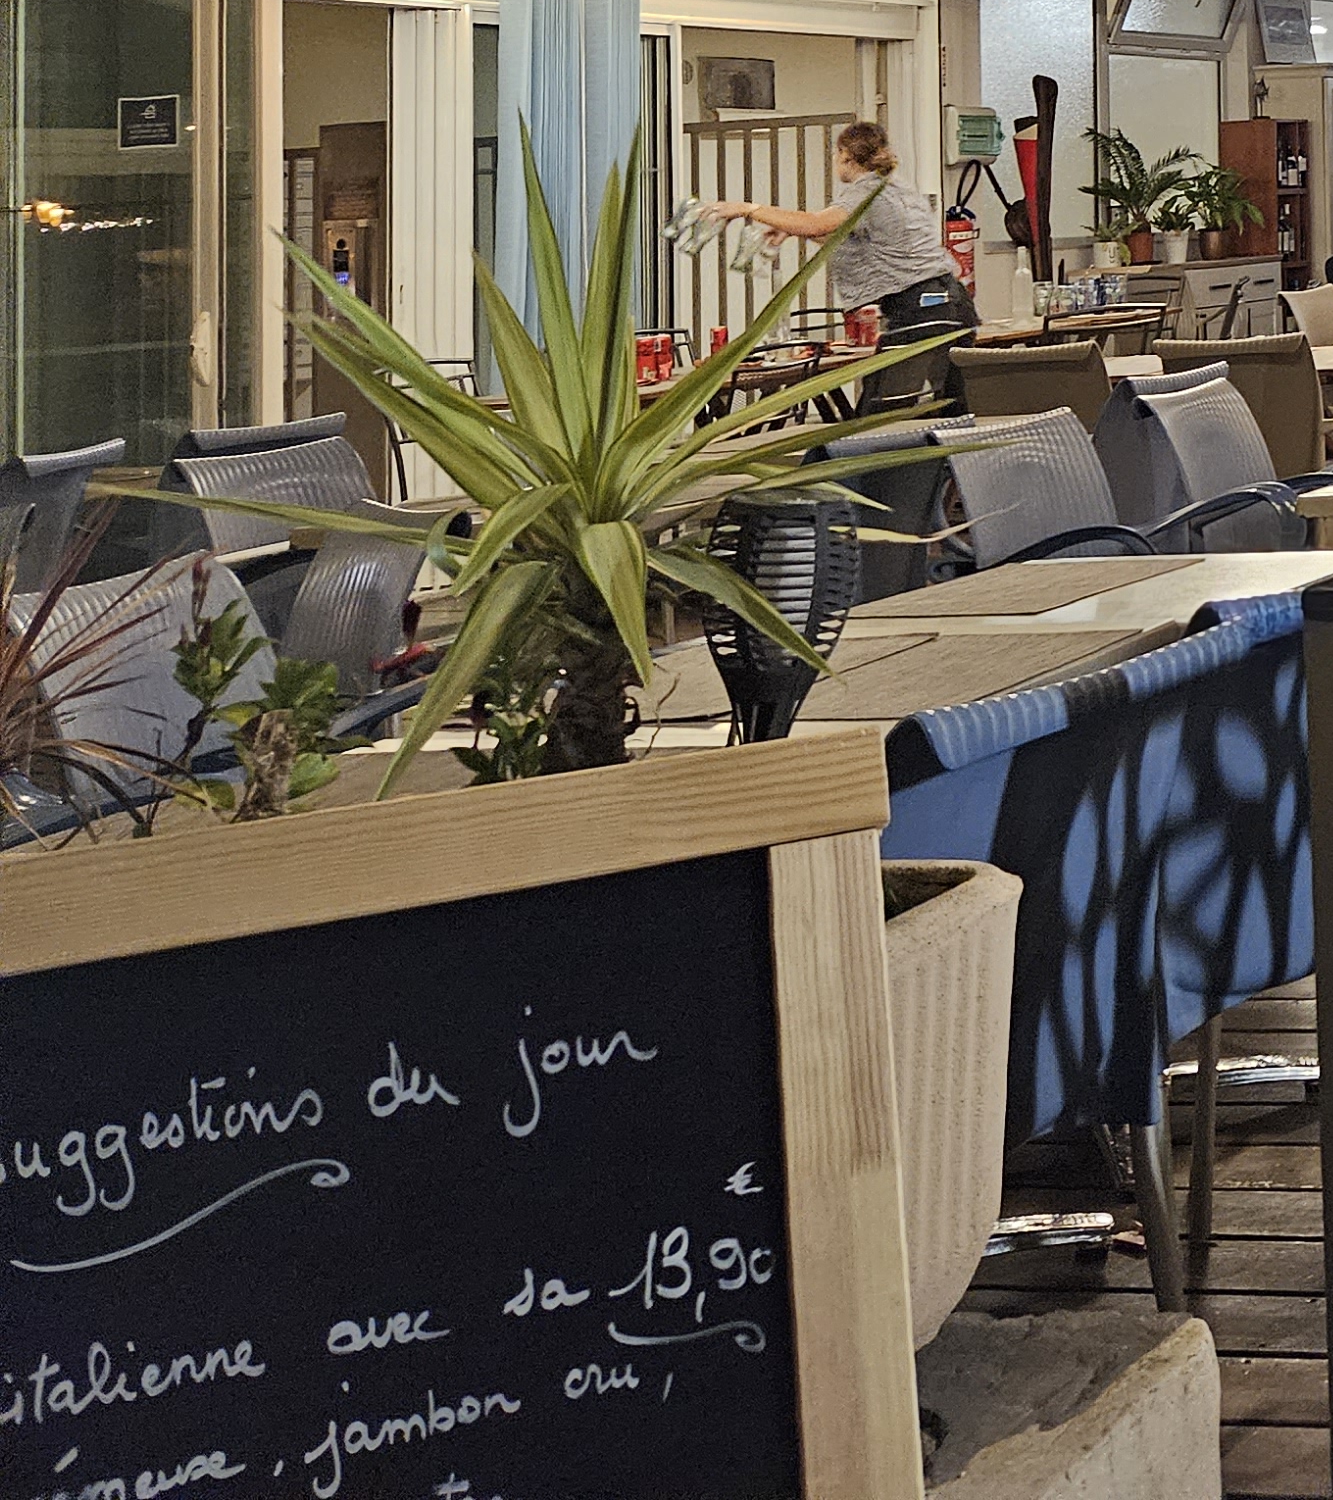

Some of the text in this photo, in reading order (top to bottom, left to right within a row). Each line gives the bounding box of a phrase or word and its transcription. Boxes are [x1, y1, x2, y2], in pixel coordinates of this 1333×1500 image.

[367, 1042, 460, 1119] du
[503, 1006, 658, 1137] jour
[328, 1309, 450, 1355] avec
[305, 1381, 520, 1499] jambon
